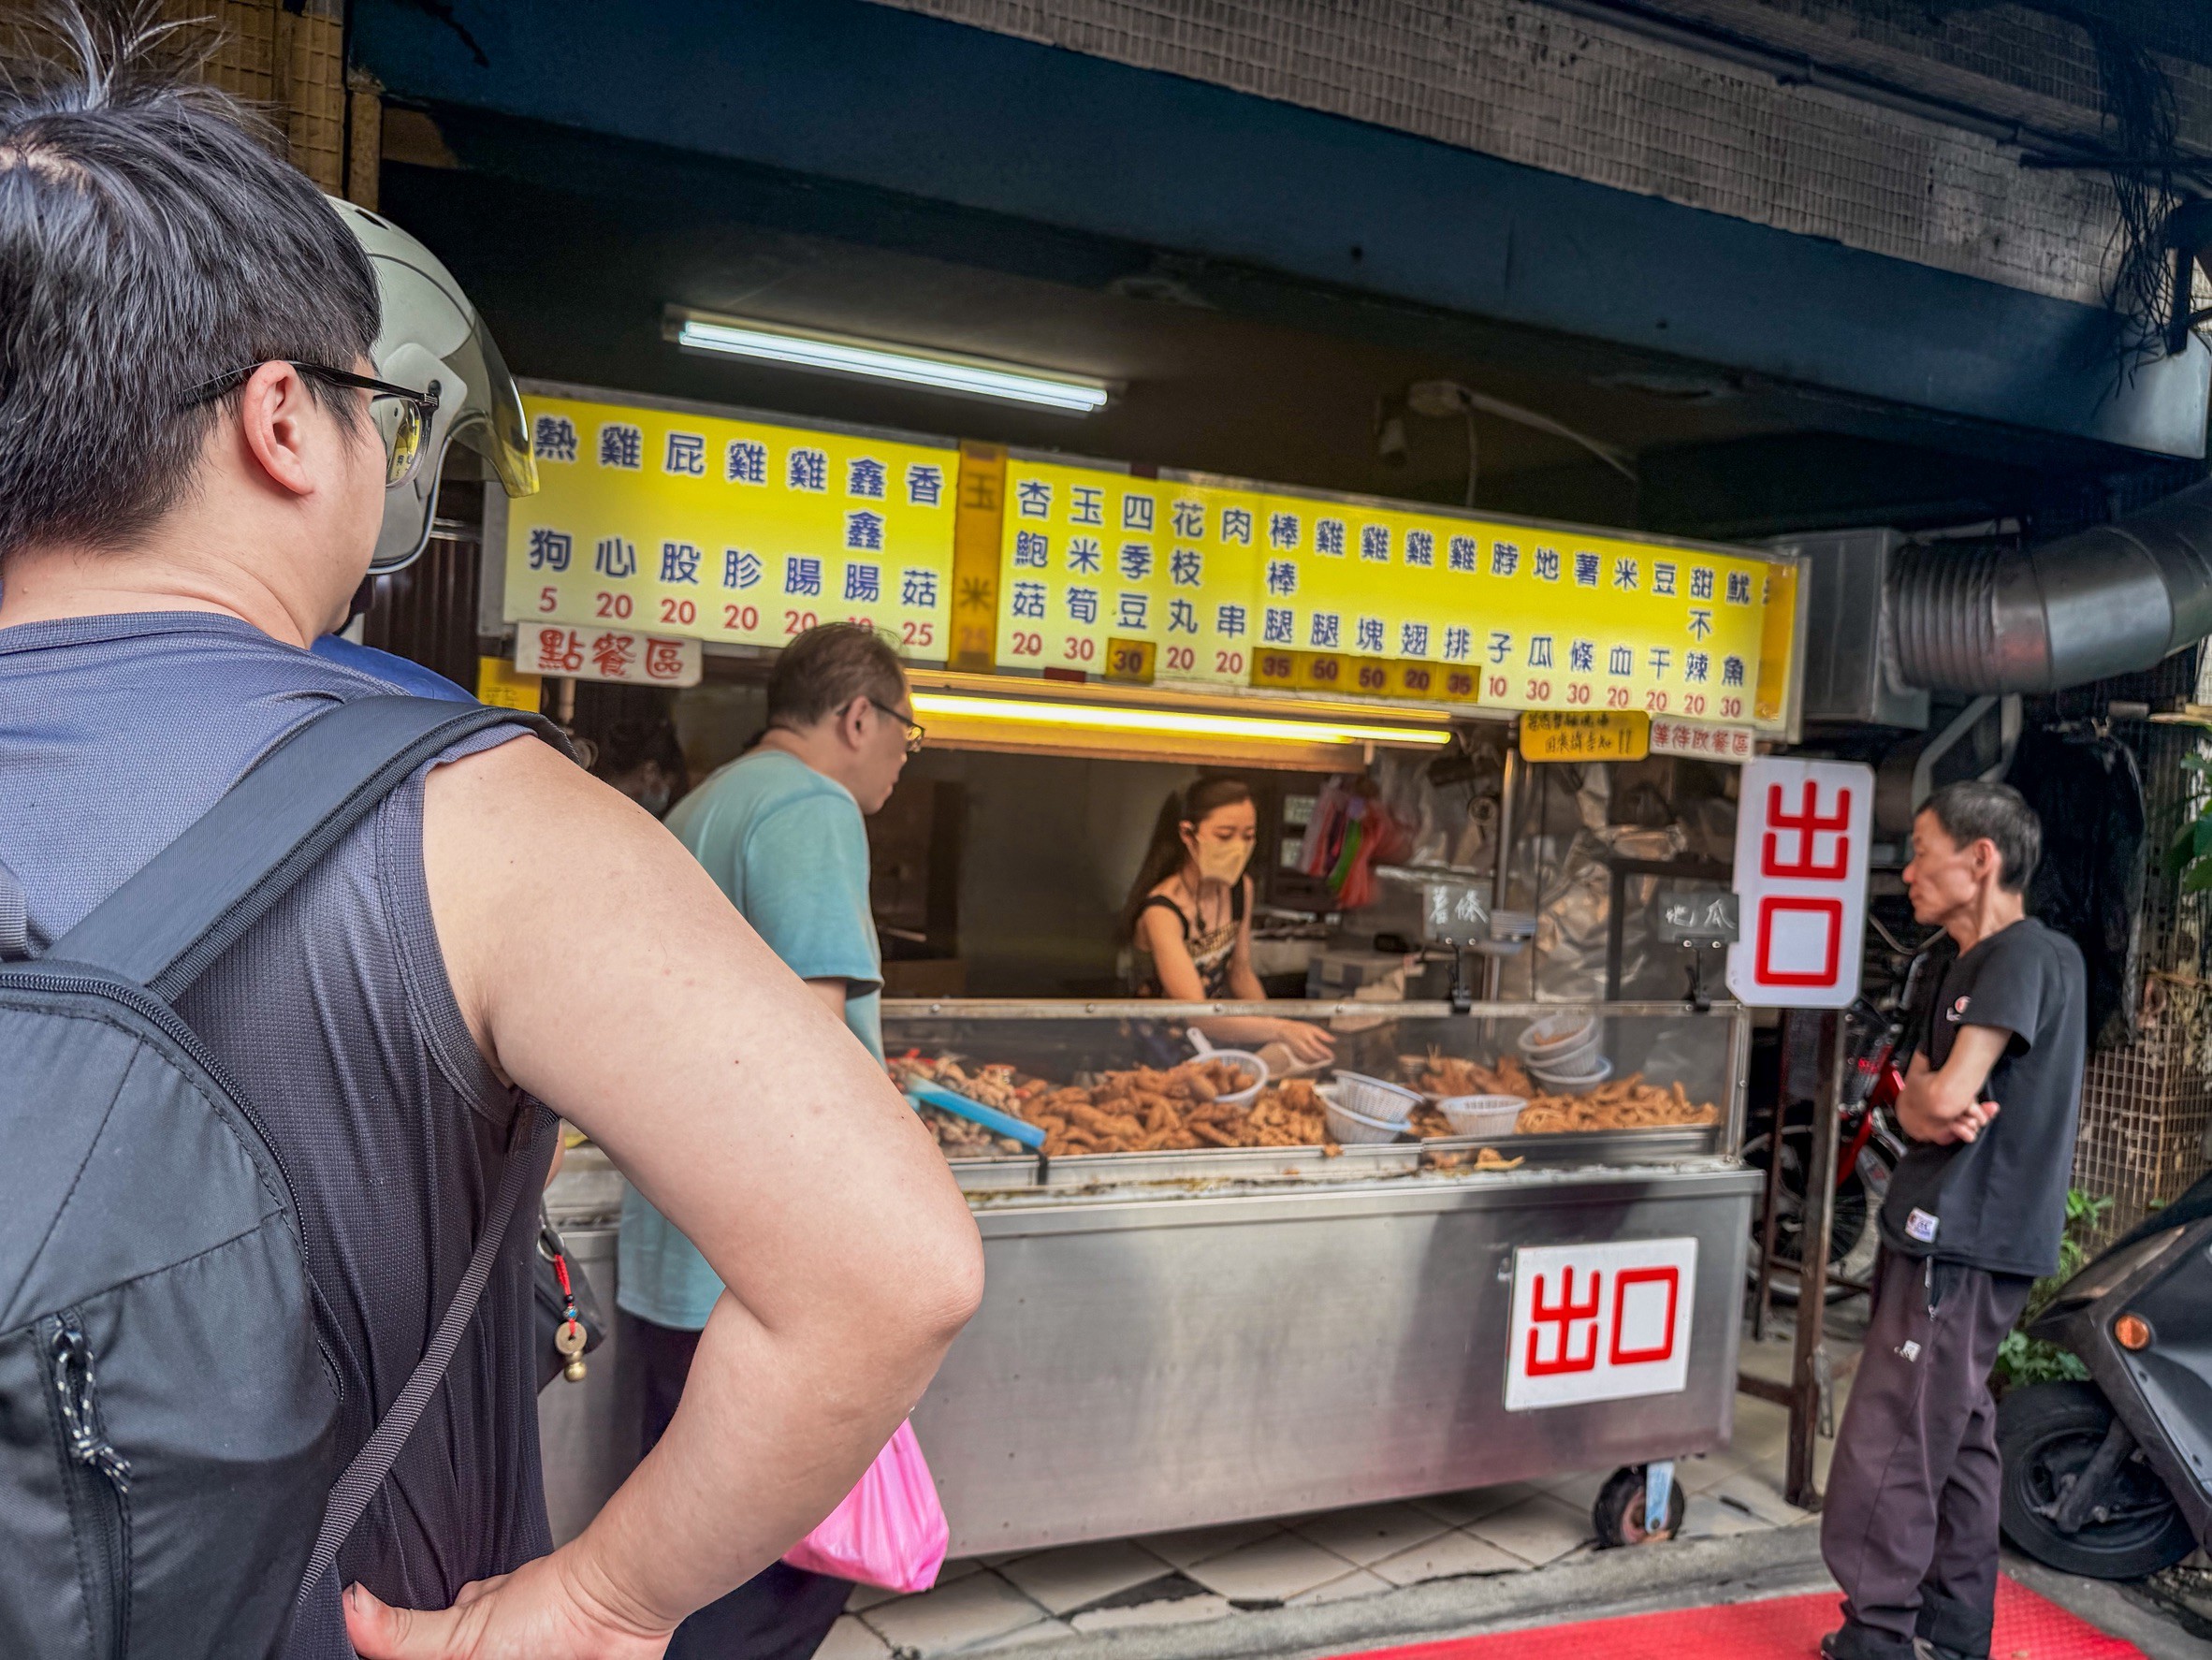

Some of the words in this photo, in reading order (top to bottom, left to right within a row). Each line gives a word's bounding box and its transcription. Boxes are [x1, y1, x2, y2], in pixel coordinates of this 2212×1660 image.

[531, 415, 577, 573] 熱狗
[595, 427, 641, 578] 雞心
[661, 433, 705, 584] 屁股
[723, 443, 765, 590] 雞胗
[784, 450, 826, 596] 雞腸
[844, 459, 887, 603] 鑫鑫腸
[902, 465, 942, 607] 香菇
[960, 472, 998, 609] 玉米
[1011, 481, 1053, 619] 杏鮑菇
[539, 586, 559, 613] 5
[596, 591, 633, 619] 20
[660, 598, 696, 625] 20
[1067, 487, 1104, 625] 玉米筍
[1117, 494, 1155, 630] 四季豆
[1168, 502, 1204, 634] 花枝丸
[1217, 508, 1252, 638] 肉串
[1264, 515, 1298, 644] 棒棒腿
[1311, 520, 1344, 648] 雞腿
[1357, 526, 1389, 652] 雞塊
[1401, 531, 1433, 656] 雞翅
[1445, 537, 1476, 660] 雞排
[1488, 543, 1518, 664] 脖子
[1528, 546, 1559, 669] 地瓜
[1570, 552, 1599, 673] 薯條
[538, 629, 684, 680] 點餐區
[723, 604, 760, 632] 20
[903, 621, 934, 647] 25
[1011, 632, 1043, 655] 20
[1064, 637, 1095, 662] 30
[1113, 649, 1143, 674] 30
[1167, 647, 1195, 671] 20
[1215, 651, 1244, 674] 20
[1608, 559, 1637, 676] 米血
[1649, 562, 1676, 680] 豆干
[1685, 567, 1713, 684] 甜不辣
[1722, 571, 1750, 687] 魷魚
[1489, 676, 1508, 697] 10
[1526, 679, 1550, 701] 30
[1566, 683, 1590, 705] 30
[1607, 686, 1629, 708] 20
[1646, 691, 1667, 712] 20
[1684, 694, 1705, 714] 20
[1720, 697, 1741, 719] 30
[1664, 898, 1736, 930] 地瓜
[1754, 779, 1852, 988] 出口
[1524, 1264, 1680, 1378] 出口
